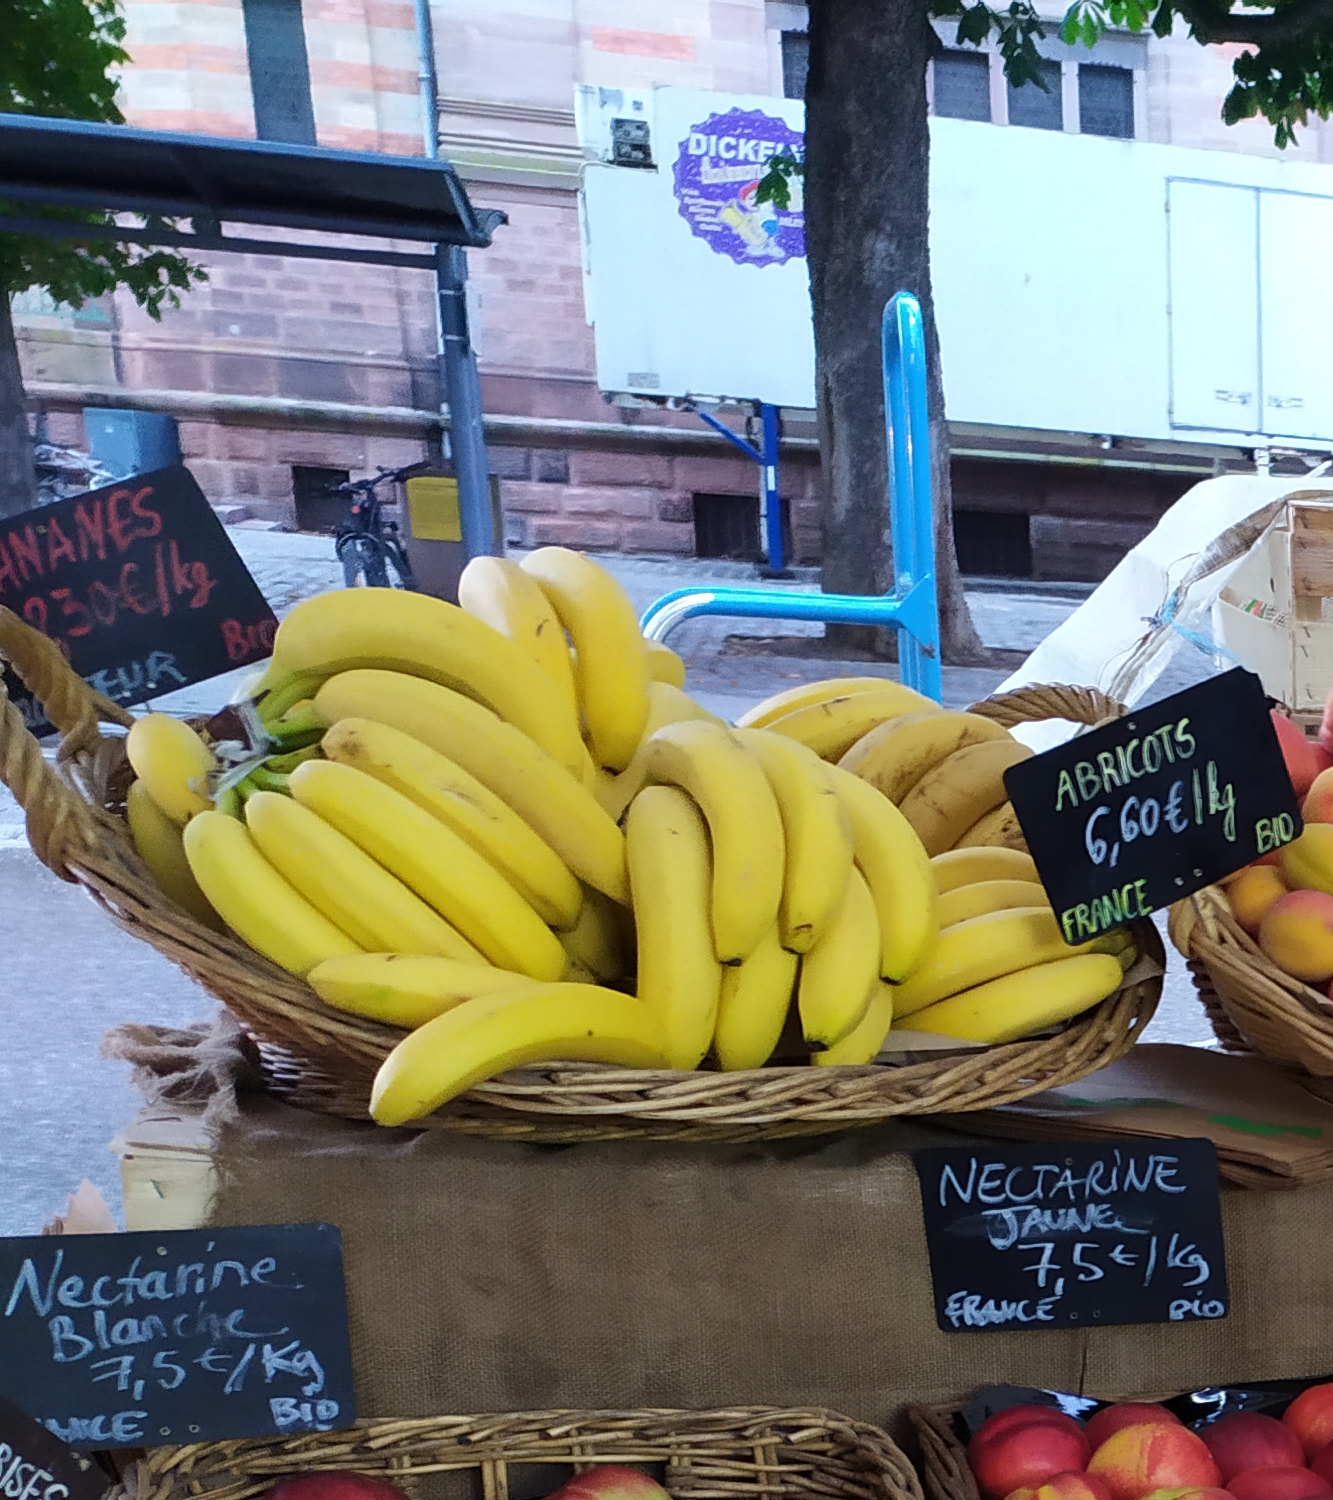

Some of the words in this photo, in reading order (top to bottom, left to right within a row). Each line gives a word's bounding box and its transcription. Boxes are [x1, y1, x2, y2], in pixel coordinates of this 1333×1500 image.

[1055, 717, 1197, 812] ABRICOTS
[1255, 812, 1295, 853] BIO
[1061, 878, 1153, 942] FRANCE
[5, 1241, 304, 1317] Nectarine
[944, 1290, 1063, 1327] FRANCE
[50, 1301, 290, 1362] Blanche
